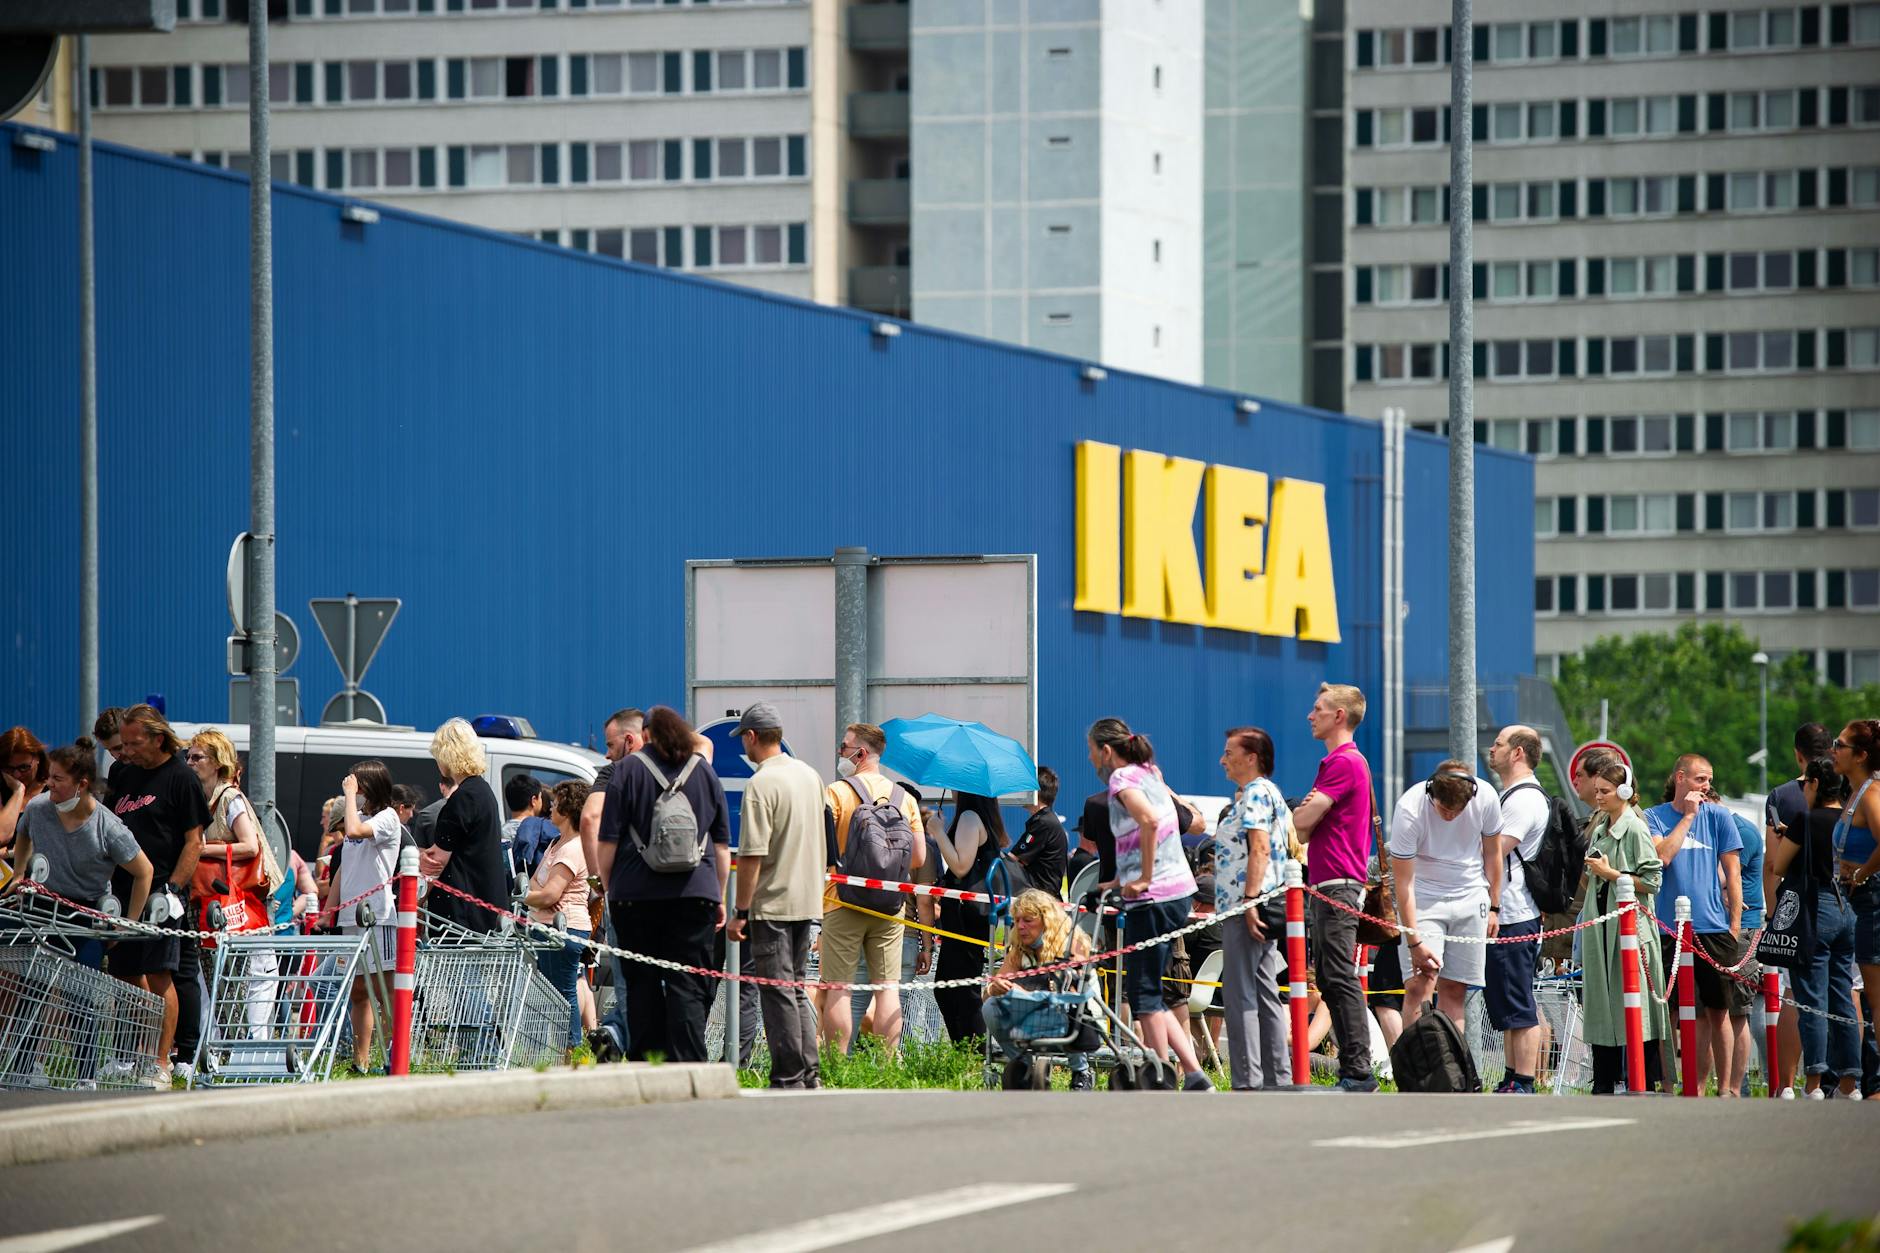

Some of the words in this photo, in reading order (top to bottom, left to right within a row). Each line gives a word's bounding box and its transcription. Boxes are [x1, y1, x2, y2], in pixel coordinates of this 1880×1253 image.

[1073, 439, 1341, 643] IKEA
[115, 794, 156, 815] Union
[1761, 930, 1799, 948] LUNDS
